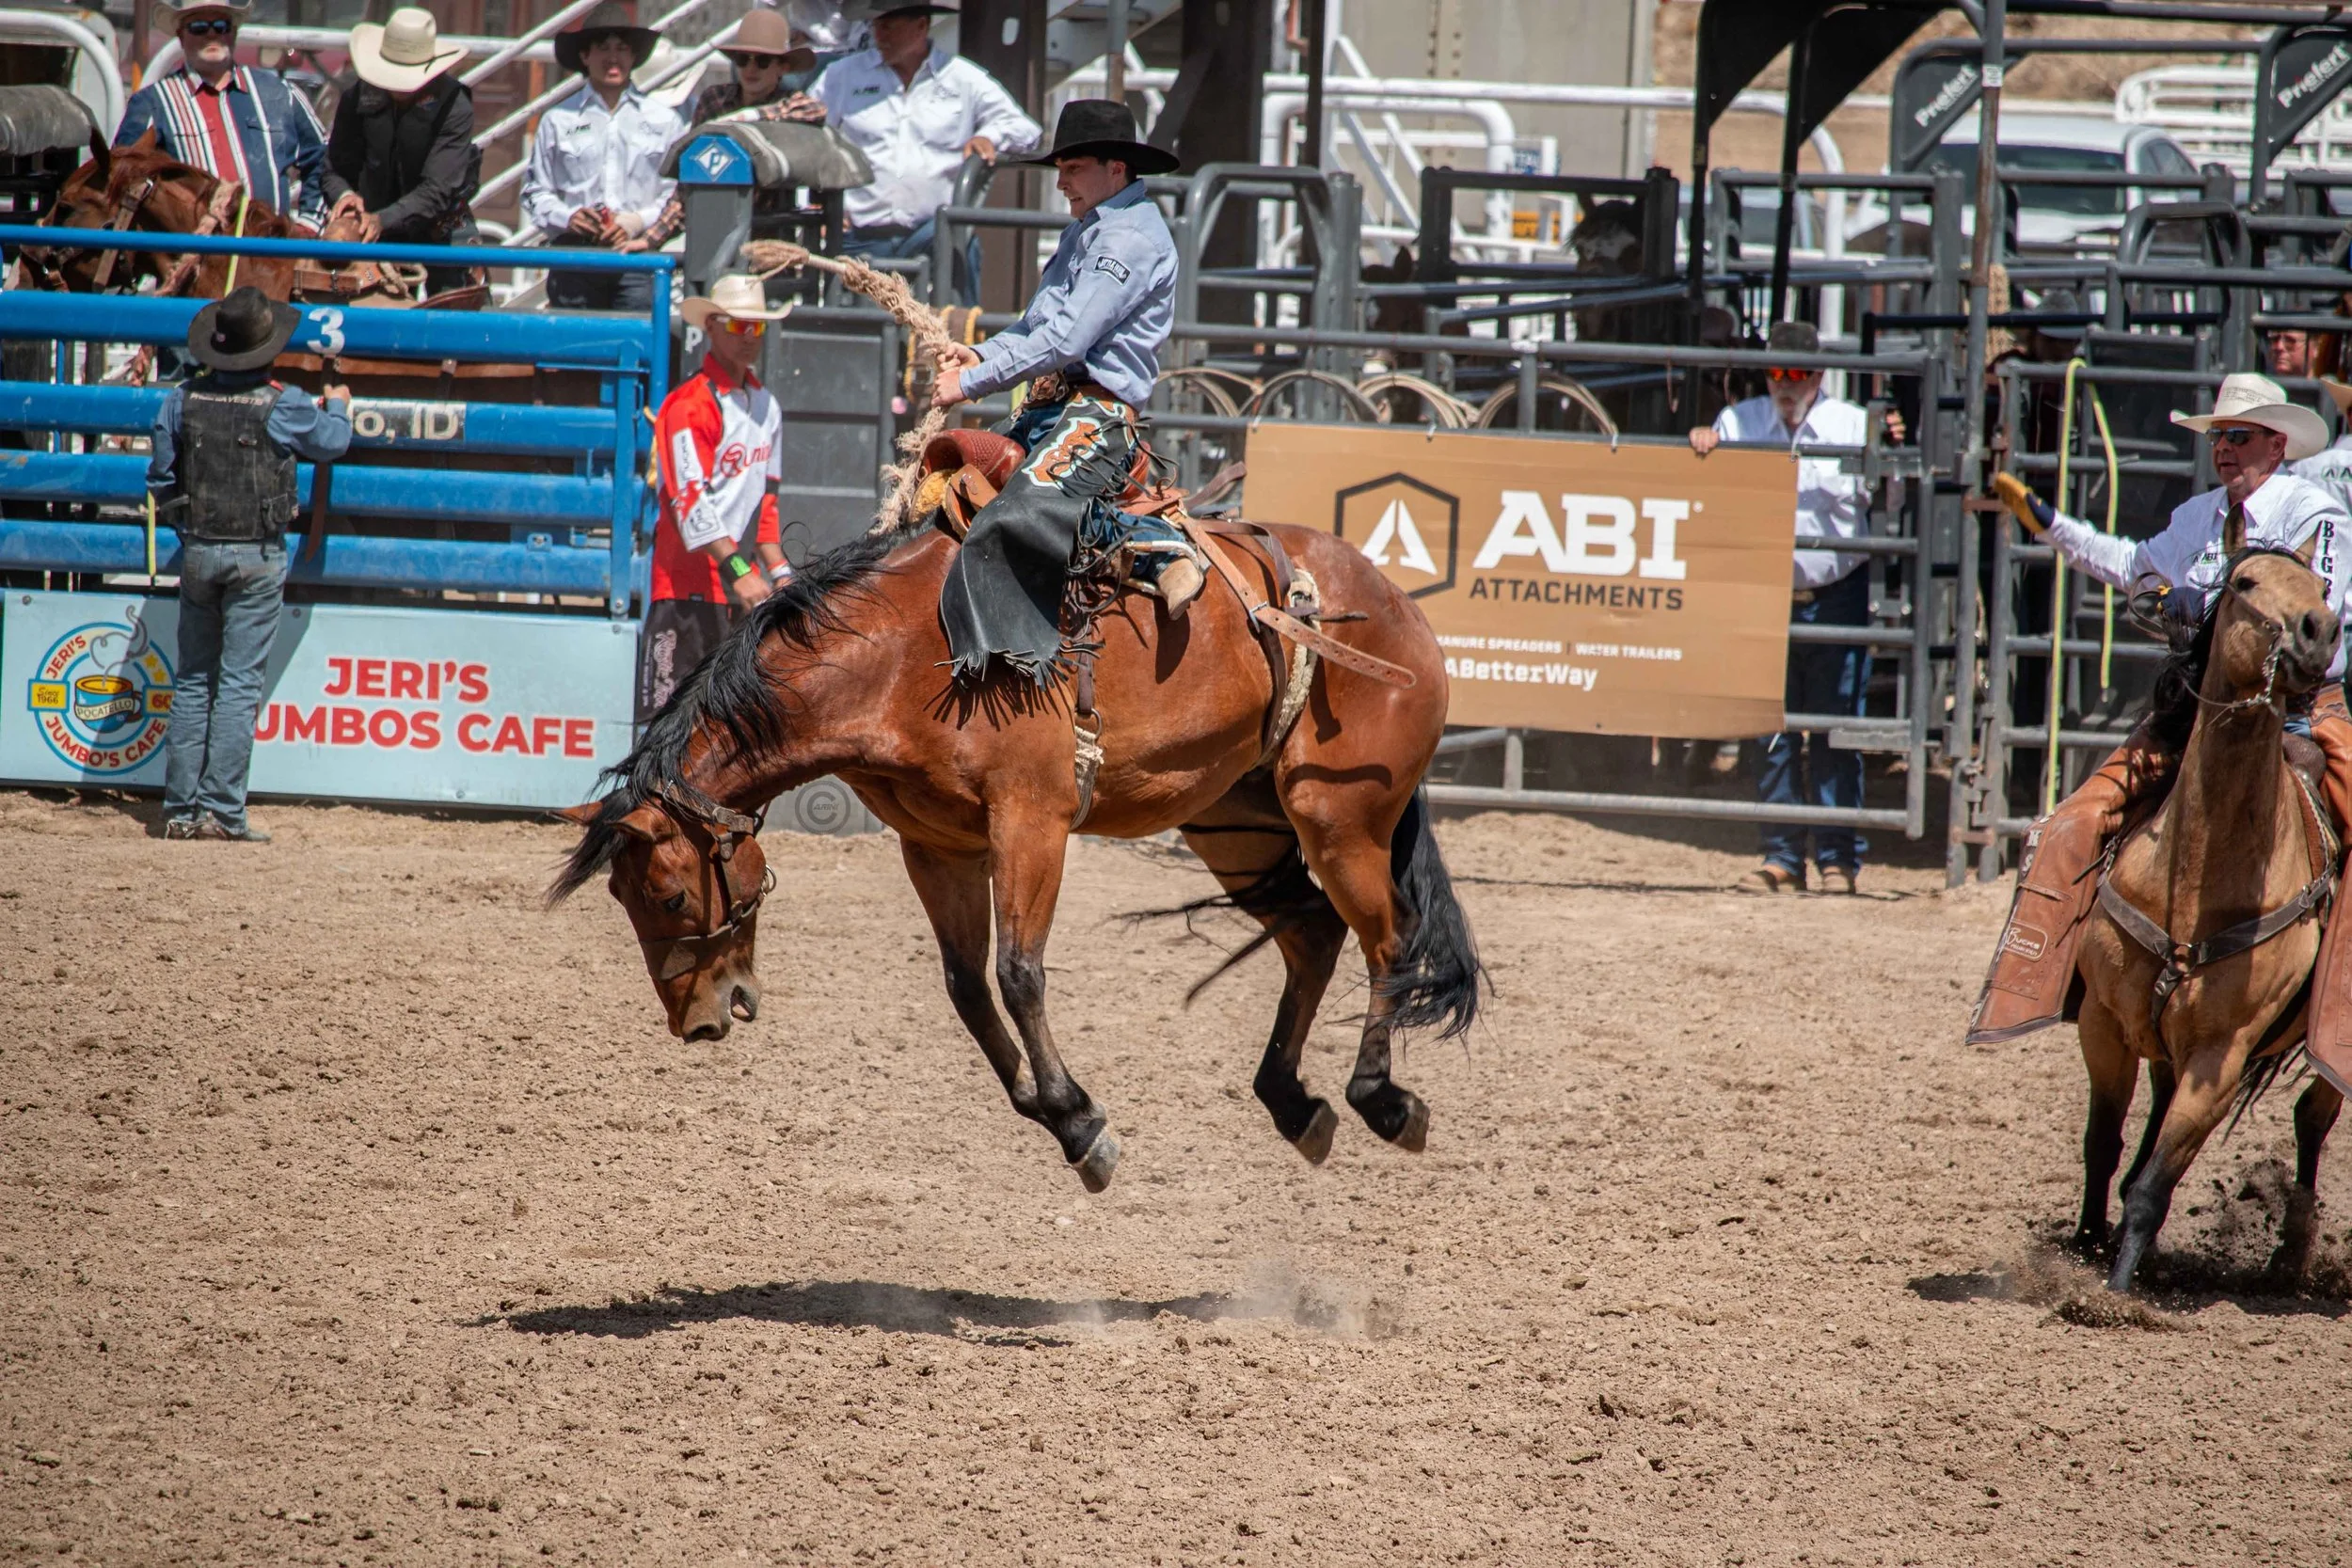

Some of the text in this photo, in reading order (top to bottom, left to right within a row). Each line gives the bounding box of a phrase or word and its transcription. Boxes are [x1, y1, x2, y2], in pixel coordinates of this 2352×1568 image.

[307, 308, 345, 355] 3
[355, 403, 459, 444] o, ID
[1472, 490, 1691, 580] ABI
[1470, 578, 1684, 611] ATTACHMENTS
[46, 635, 87, 678] JERI'S
[1487, 638, 1563, 654] SPREADERS
[1575, 642, 1618, 657] WATER
[1622, 644, 1683, 661] TRAILERS
[325, 657, 489, 704] JERI'S
[1445, 657, 1598, 691] ABetterWay
[76, 699, 132, 719] POCATELLO
[46, 717, 166, 768] JUMBO'S CAFE
[254, 705, 594, 758] UMBOS CAFE
